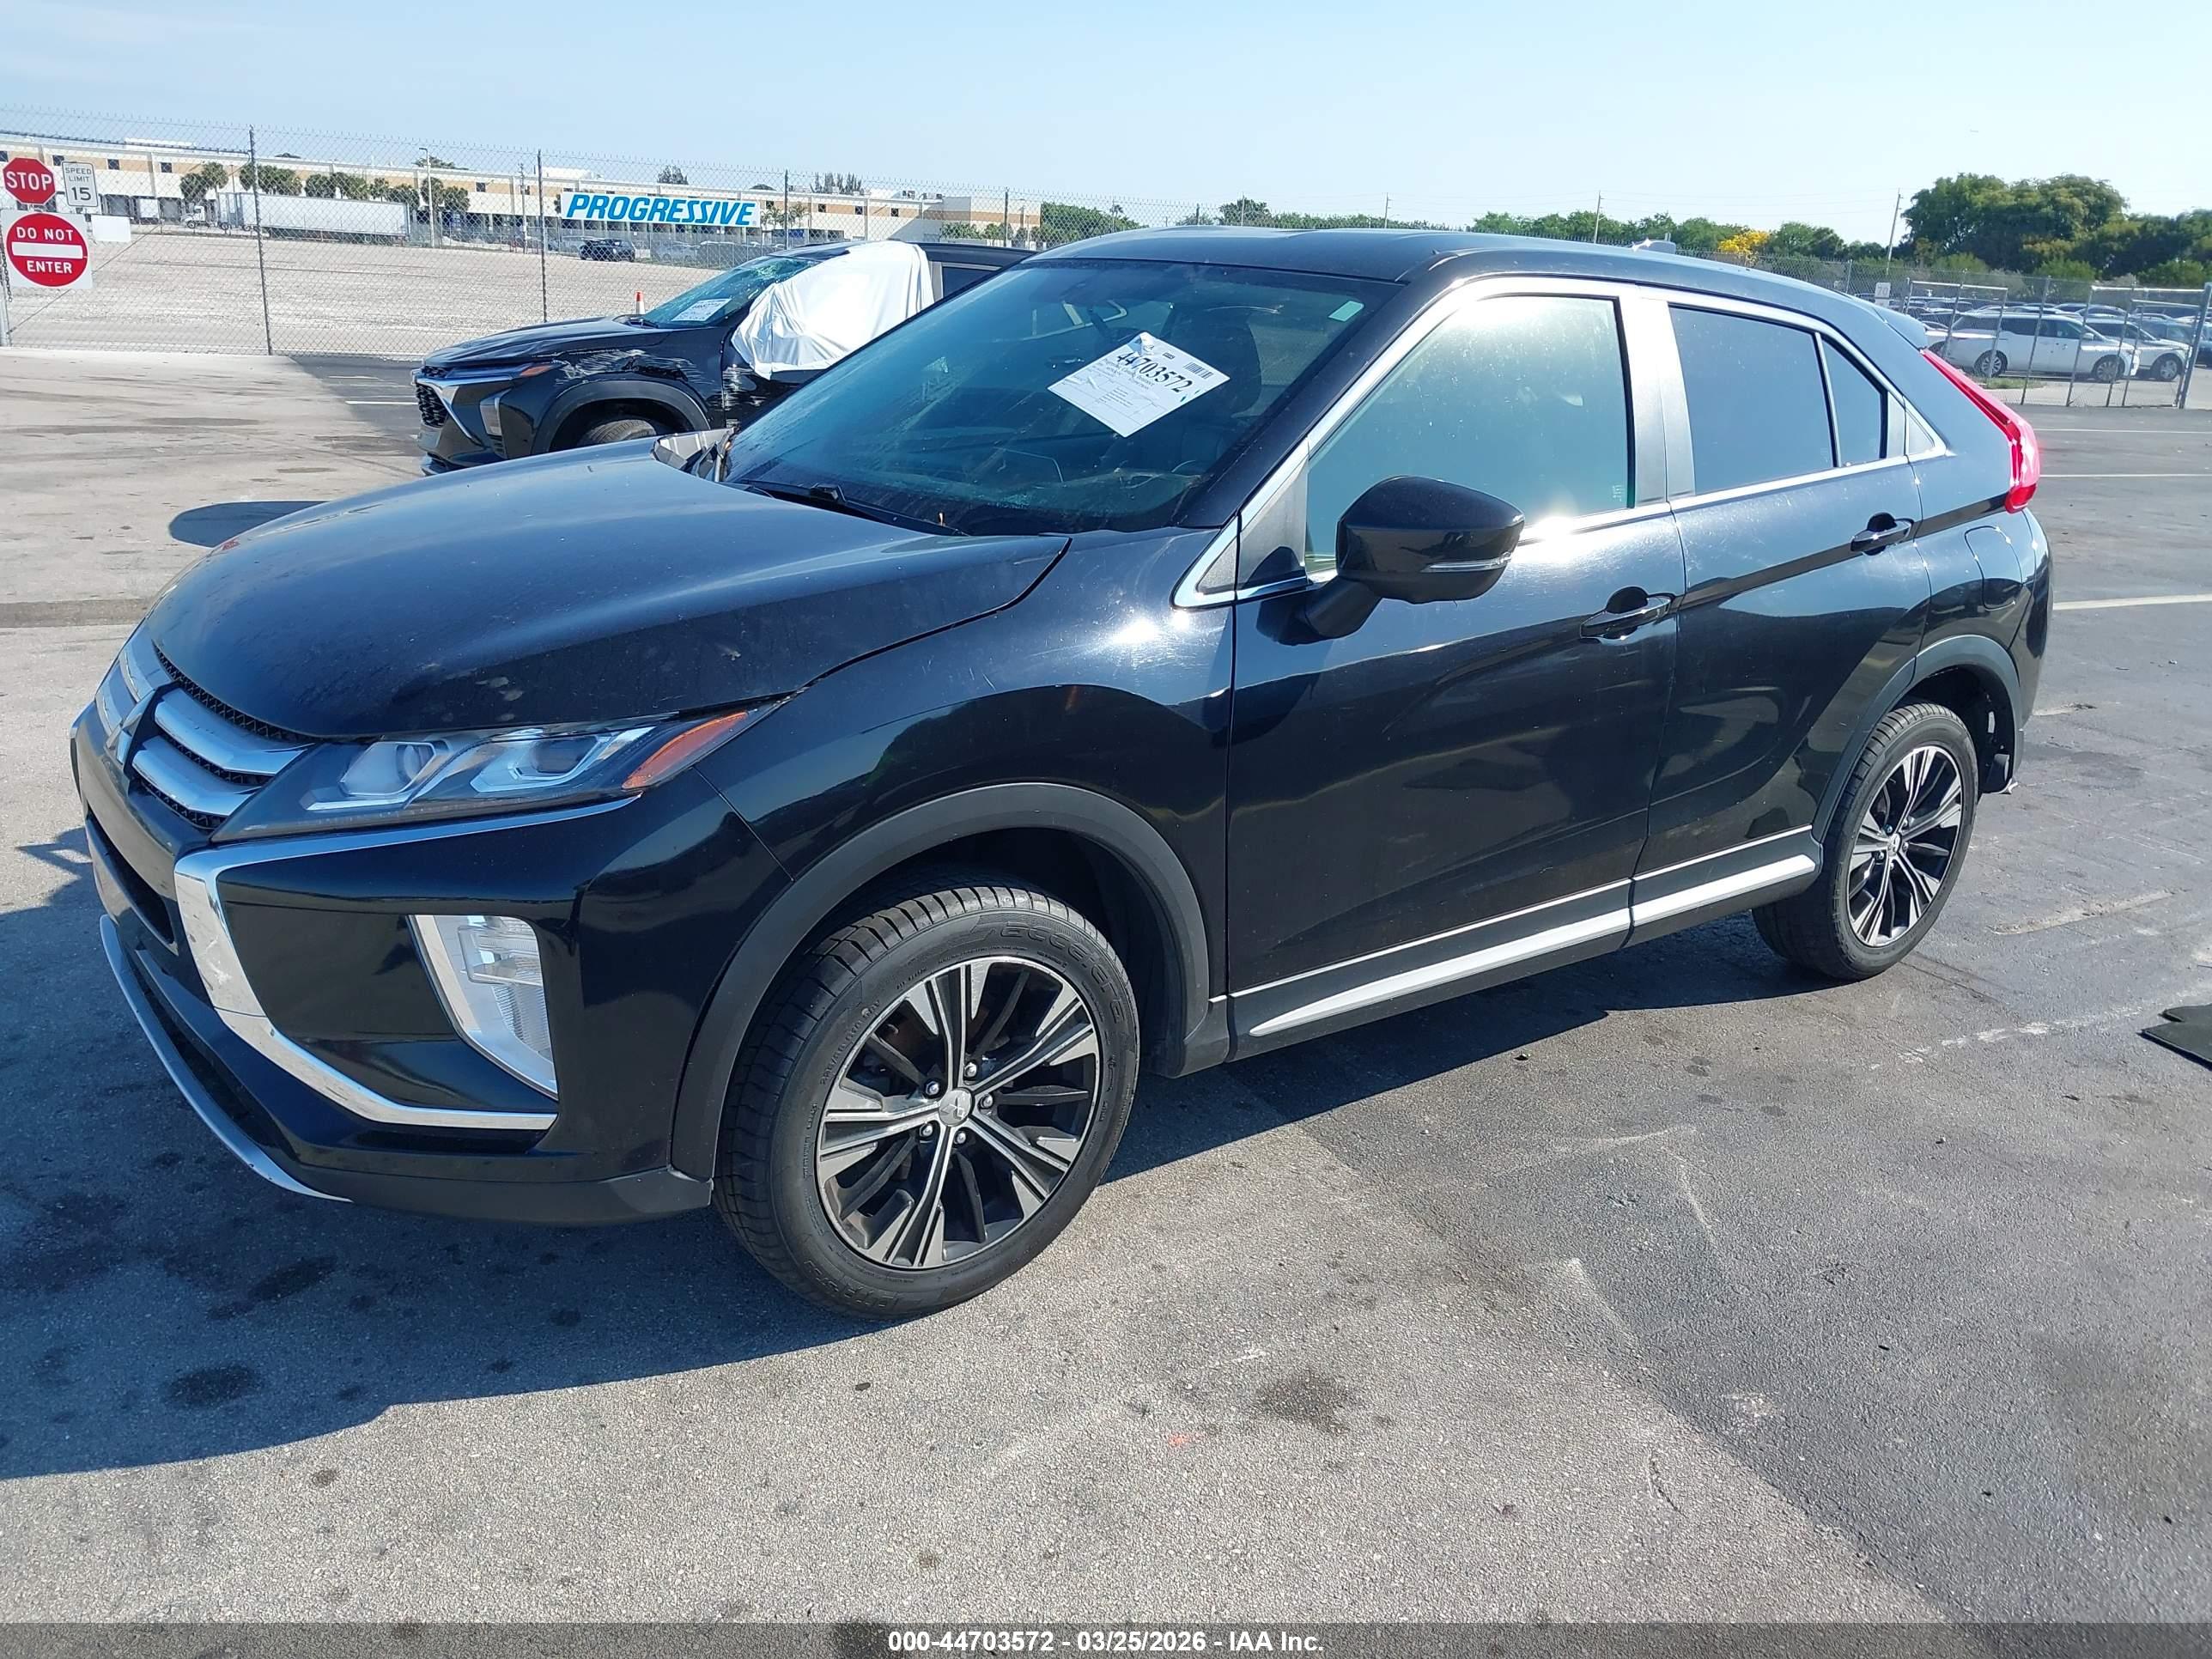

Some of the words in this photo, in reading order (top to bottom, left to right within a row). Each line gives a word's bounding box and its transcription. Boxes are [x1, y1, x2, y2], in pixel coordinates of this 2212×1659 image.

[7, 172, 52, 191] STOP
[71, 187, 91, 201] 15
[567, 195, 756, 225] PROGRESSIVE
[16, 227, 37, 239] DO
[45, 228, 74, 241] NOT
[27, 260, 72, 274] ENTER
[1117, 352, 1193, 392] 44703572
